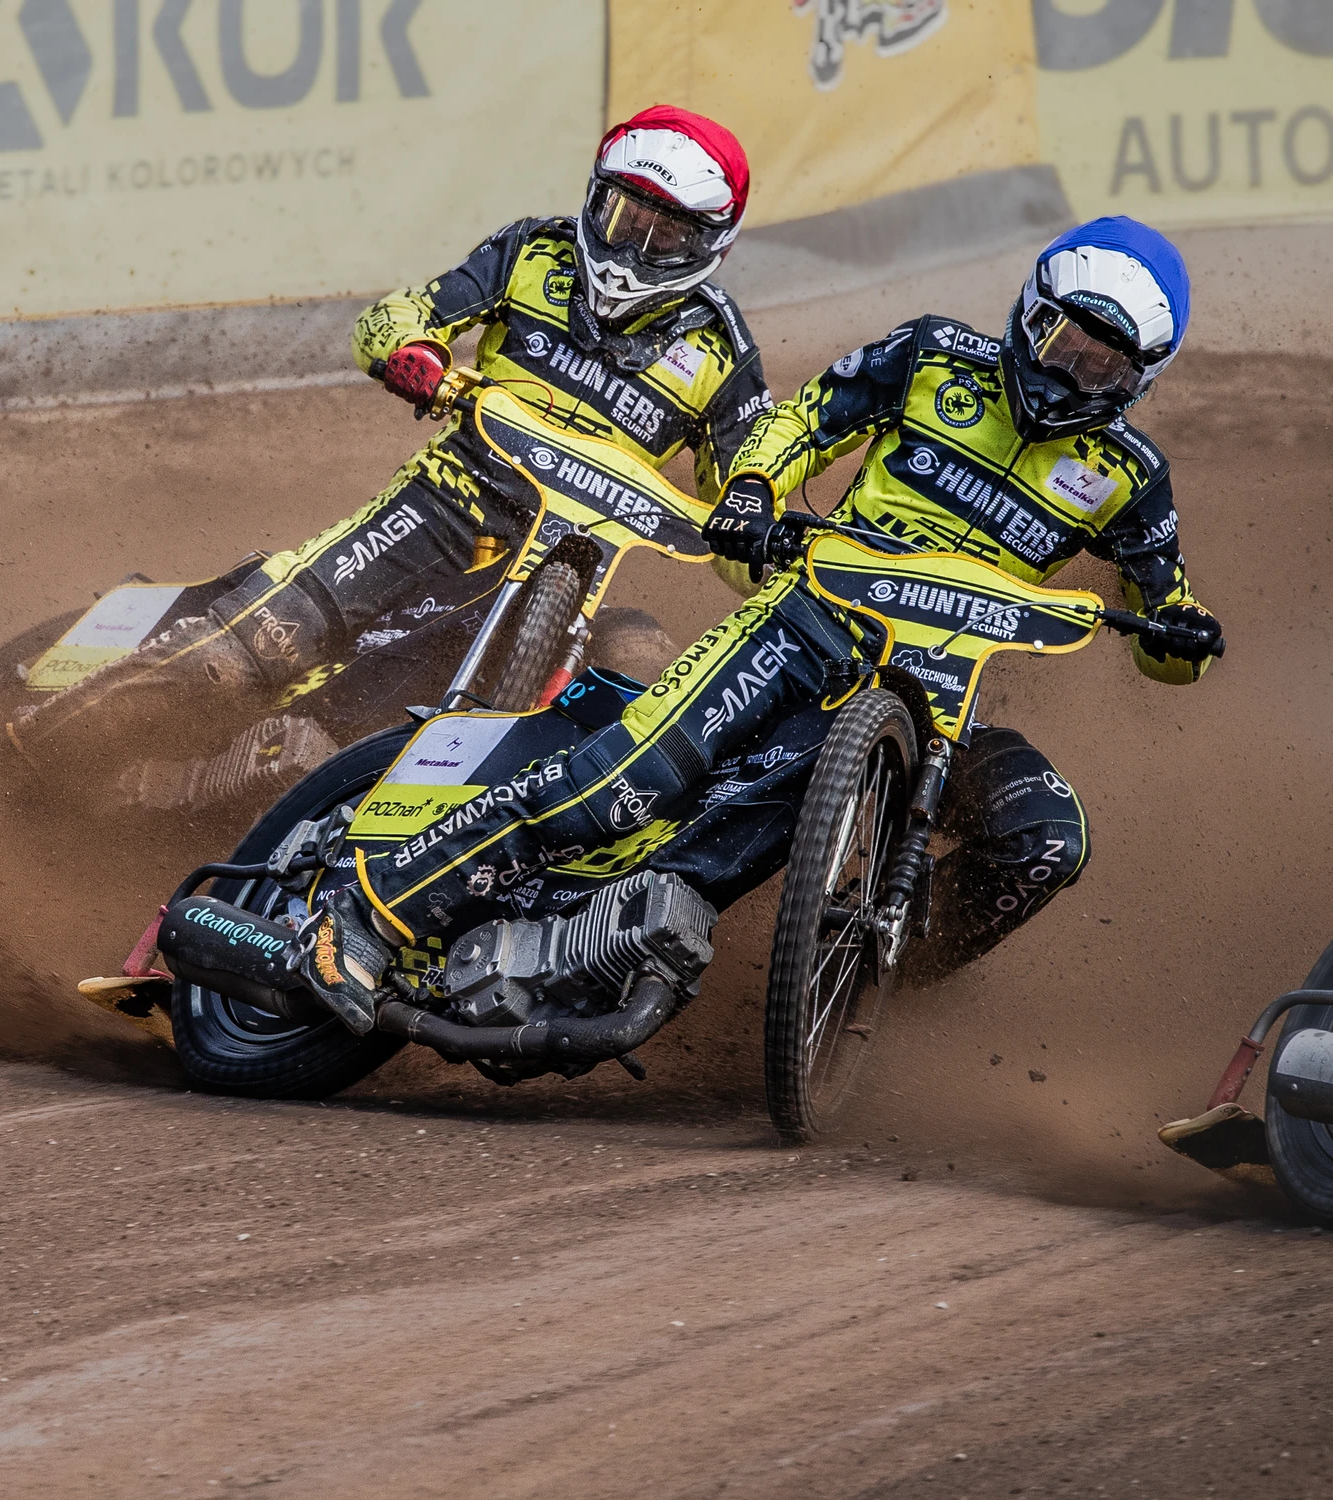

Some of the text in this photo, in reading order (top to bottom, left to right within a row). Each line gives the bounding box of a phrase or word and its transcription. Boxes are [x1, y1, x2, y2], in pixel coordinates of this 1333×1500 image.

[106, 145, 356, 191] KOLOROWYCH
[634, 160, 673, 182] SHOEI
[957, 344, 998, 362] drukarnia
[959, 332, 1001, 354] mjp
[549, 342, 665, 434] HUNTERS
[610, 407, 654, 443] SECURITY
[1123, 431, 1161, 469] GRUPA SOBECKI
[556, 457, 663, 531] HUNTERS
[1052, 474, 1095, 505] Metalka
[708, 517, 750, 532] FOX
[935, 461, 1063, 556] HUNTERS
[999, 530, 1045, 564] SECURITY
[899, 581, 1021, 633] HUNTERS
[966, 619, 1015, 641] SECURITY
[414, 758, 463, 768] Metalkas
[611, 777, 654, 826] PROM
[987, 775, 1042, 802] Mercedes-Benz
[1005, 786, 1032, 802] Motors
[393, 763, 564, 869] BLACKWATER
